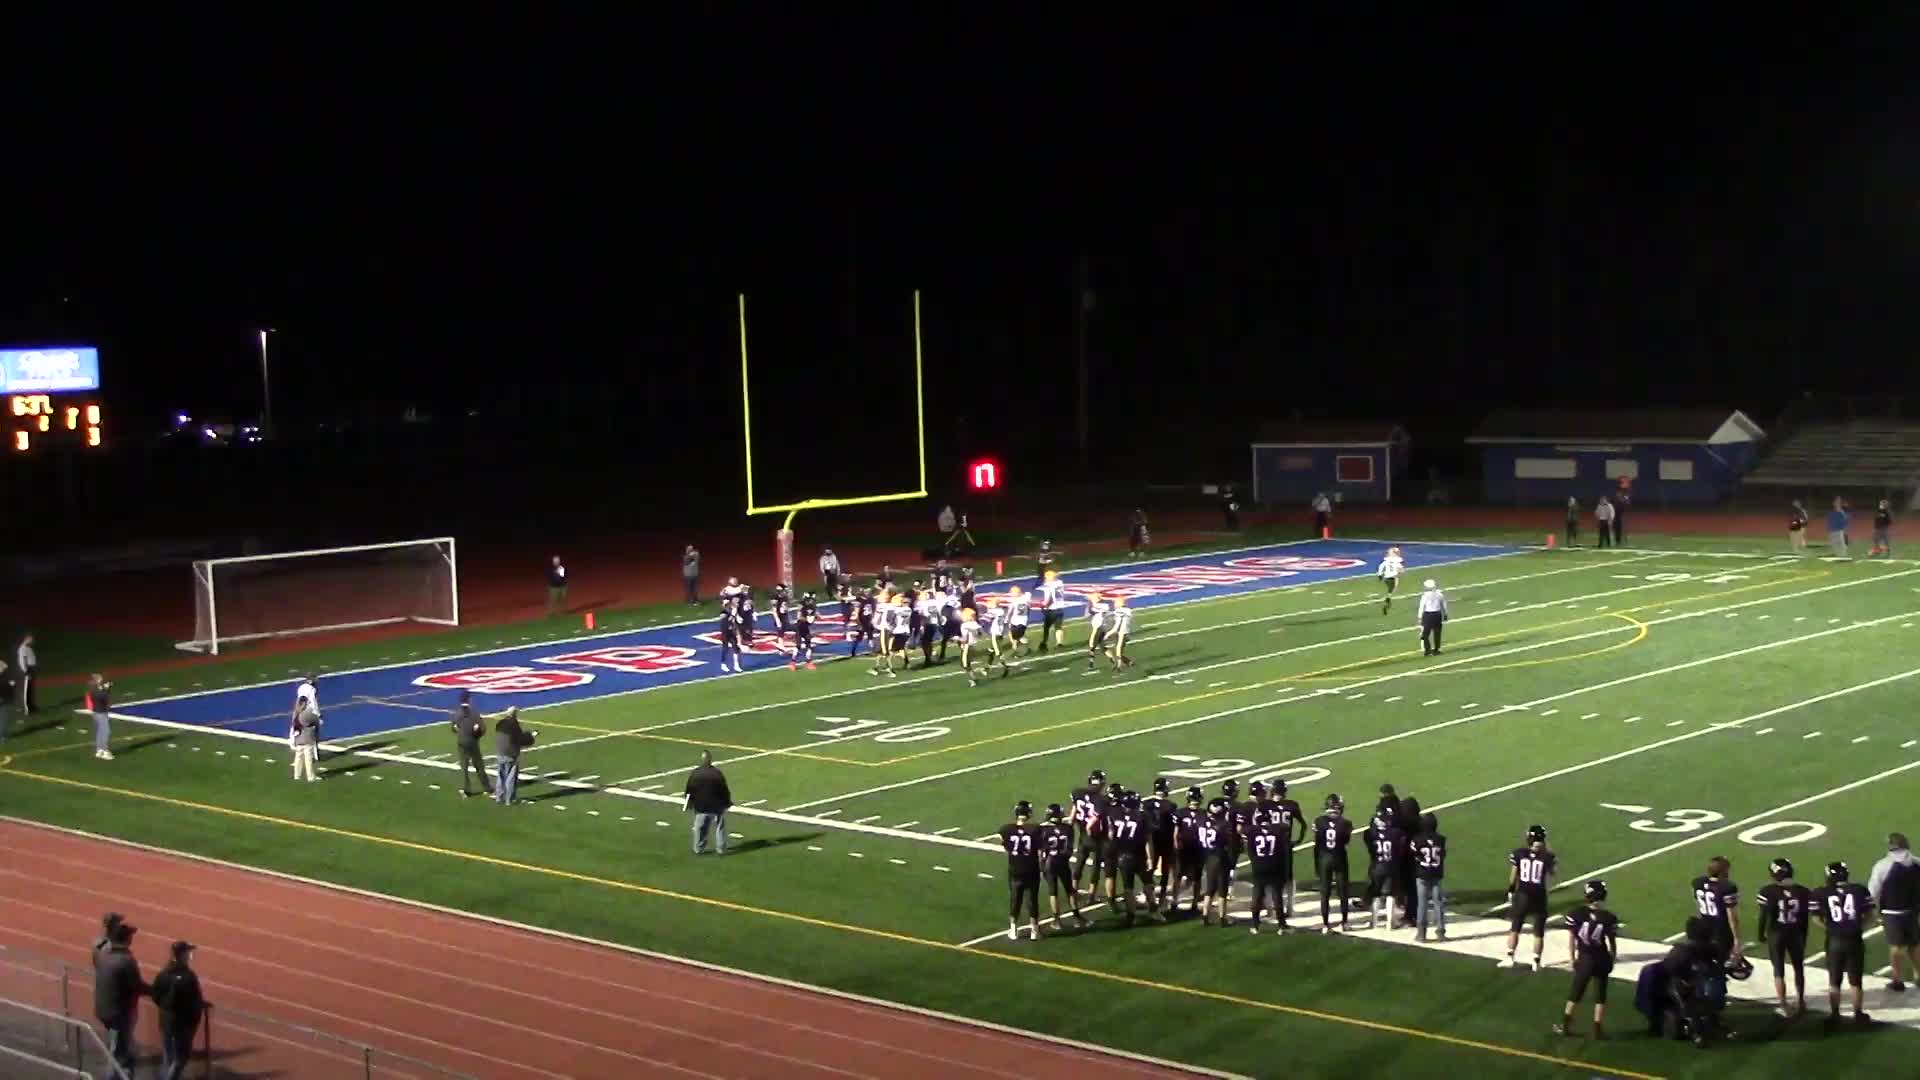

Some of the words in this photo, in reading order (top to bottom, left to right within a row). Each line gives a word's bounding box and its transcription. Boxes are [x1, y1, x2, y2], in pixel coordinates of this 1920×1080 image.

[1630, 809, 1827, 845] 30
[1255, 835, 1276, 857] 27
[1520, 858, 1543, 883] 80
[1777, 899, 1800, 923] 12
[1828, 893, 1856, 922] 64
